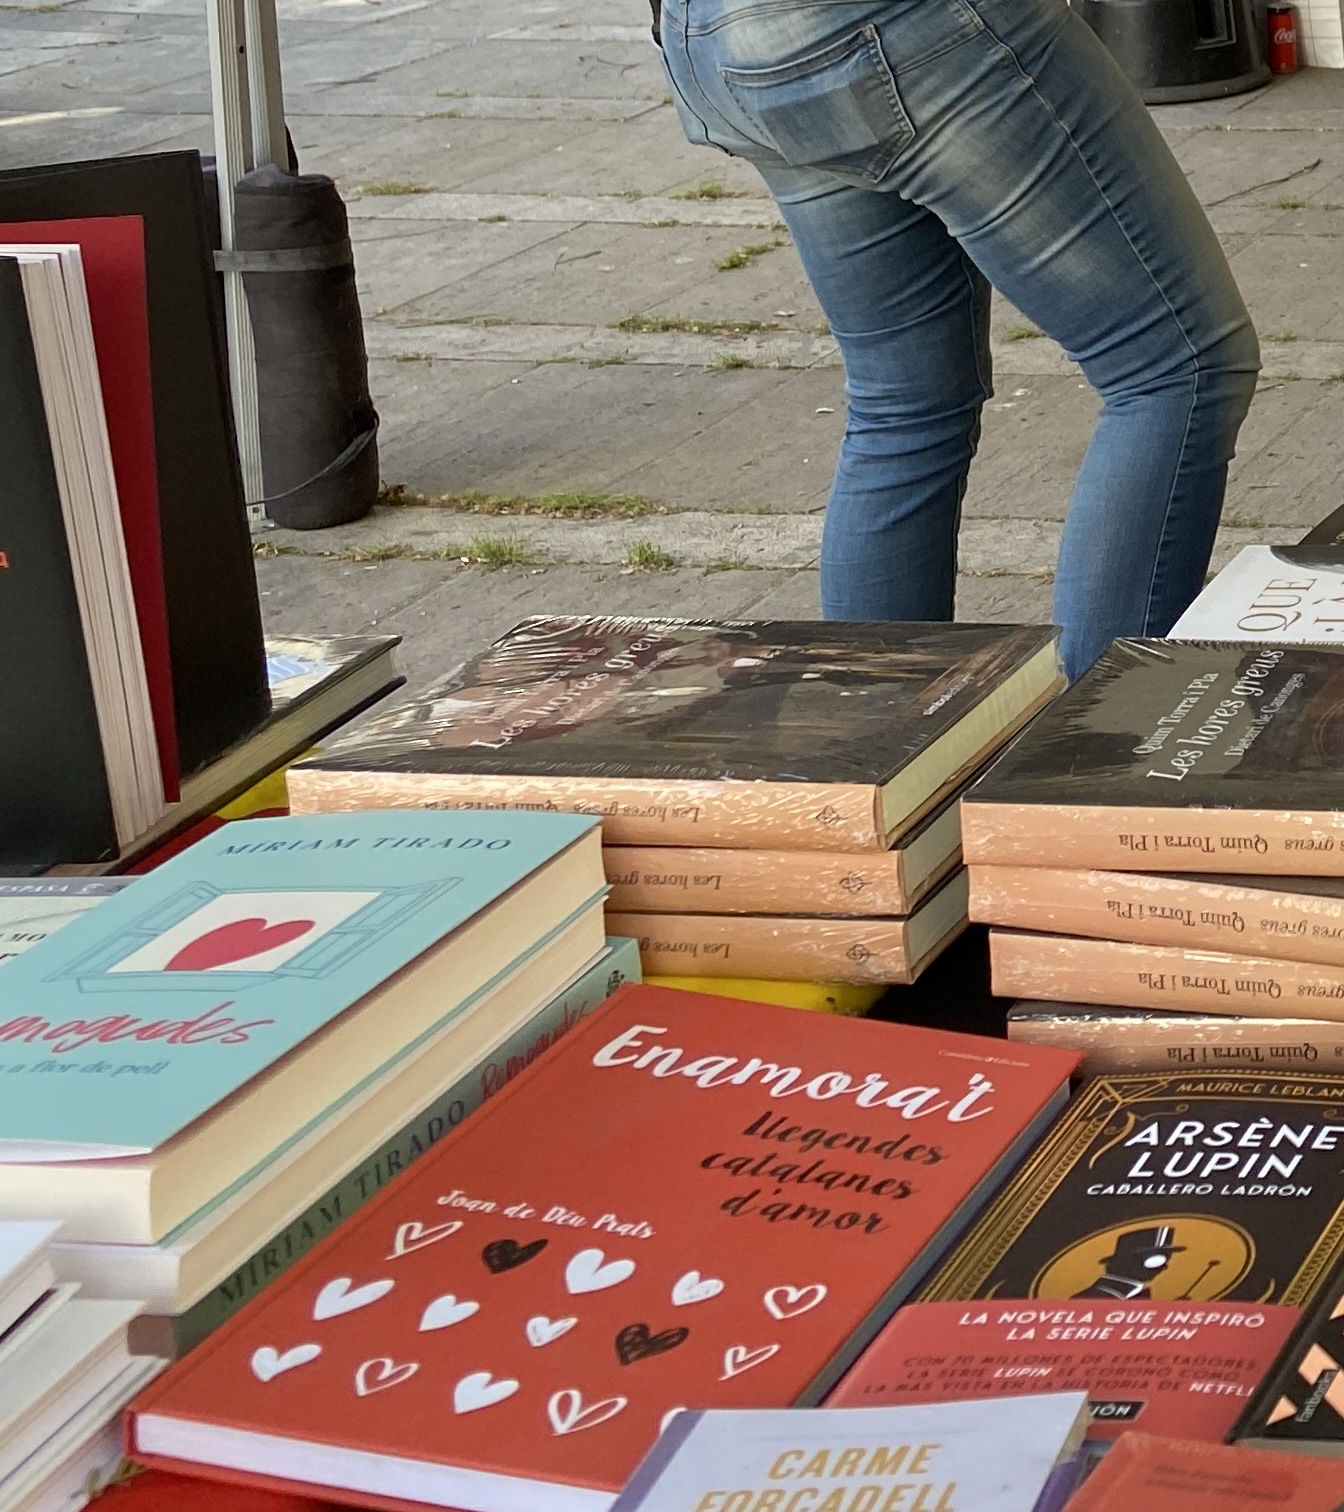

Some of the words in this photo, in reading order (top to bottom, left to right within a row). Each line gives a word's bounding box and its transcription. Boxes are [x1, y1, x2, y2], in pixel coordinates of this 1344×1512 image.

[1236, 578, 1317, 634] QUE
[1146, 748, 1204, 782] Les
[1176, 699, 1246, 747] hores
[1230, 649, 1285, 697] greus
[371, 835, 514, 852] TIRADO
[1118, 834, 1149, 852] Pla
[1163, 835, 1217, 853] Torra
[1219, 835, 1270, 854] Quim
[1284, 838, 1335, 853] greus
[643, 873, 688, 890] hores
[694, 876, 723, 892] Les
[1106, 899, 1134, 919] Pla
[1149, 906, 1196, 927] Torra
[1200, 910, 1248, 932] Quim
[1259, 918, 1309, 936] greus
[647, 939, 698, 957] hores
[703, 942, 731, 959] Les
[1137, 972, 1167, 991] Pla
[1181, 975, 1231, 995] Torra
[1234, 978, 1283, 999] Quim
[1166, 1046, 1196, 1063] Pla
[1212, 1046, 1265, 1063] Torra
[1269, 1042, 1319, 1062] Quim
[111, 1060, 170, 1078] pell
[592, 1023, 996, 1126] Enamora't
[1176, 1081, 1263, 1095] MAURICE
[353, 1099, 466, 1202] TIRADO
[1127, 1151, 1304, 1179] LUPIN
[700, 1151, 922, 1200] catalanes
[1086, 1182, 1214, 1197] CABALLERO
[1220, 1183, 1313, 1198] LADRÓN
[437, 1190, 502, 1215] Joan
[541, 1205, 588, 1229] Déu
[592, 1213, 657, 1240] Prats
[719, 1187, 891, 1236] d'amor
[958, 1311, 990, 1326] LA
[998, 1310, 1096, 1326] NOVELA
[1104, 1311, 1155, 1326] QUE
[1163, 1310, 1267, 1329] INSPIRÓ
[1006, 1327, 1037, 1342] LA
[1046, 1326, 1114, 1341] SERIE
[1121, 1326, 1200, 1342] LUPIN
[992, 1366, 1053, 1379] LUPIN
[766, 1443, 942, 1480] CARME
